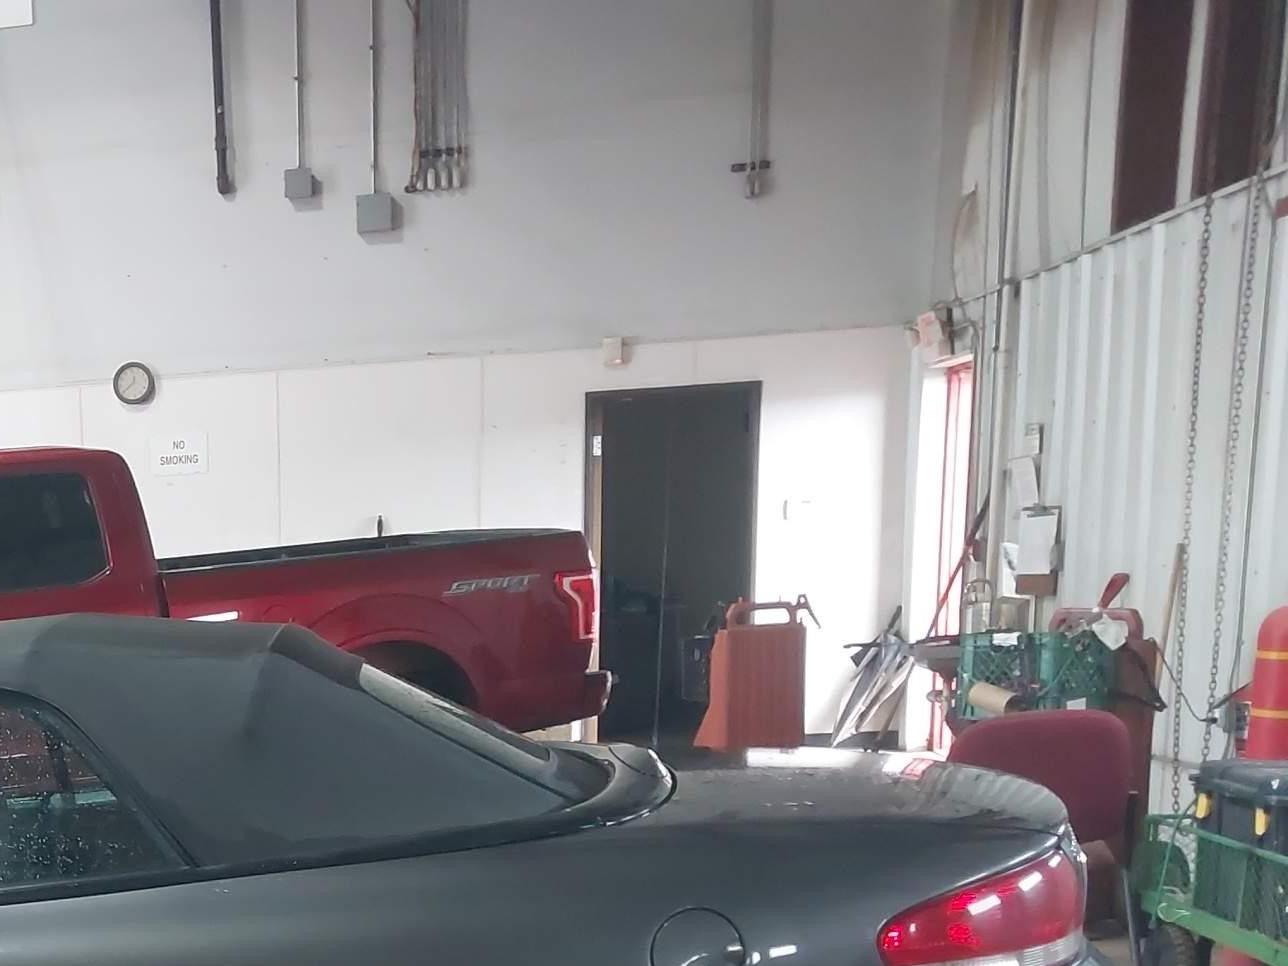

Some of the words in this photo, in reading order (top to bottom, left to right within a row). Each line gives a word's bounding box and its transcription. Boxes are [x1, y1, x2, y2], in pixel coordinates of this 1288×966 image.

[172, 440, 185, 450] NO
[160, 454, 199, 466] SMOKING
[443, 575, 540, 596] SPORT
